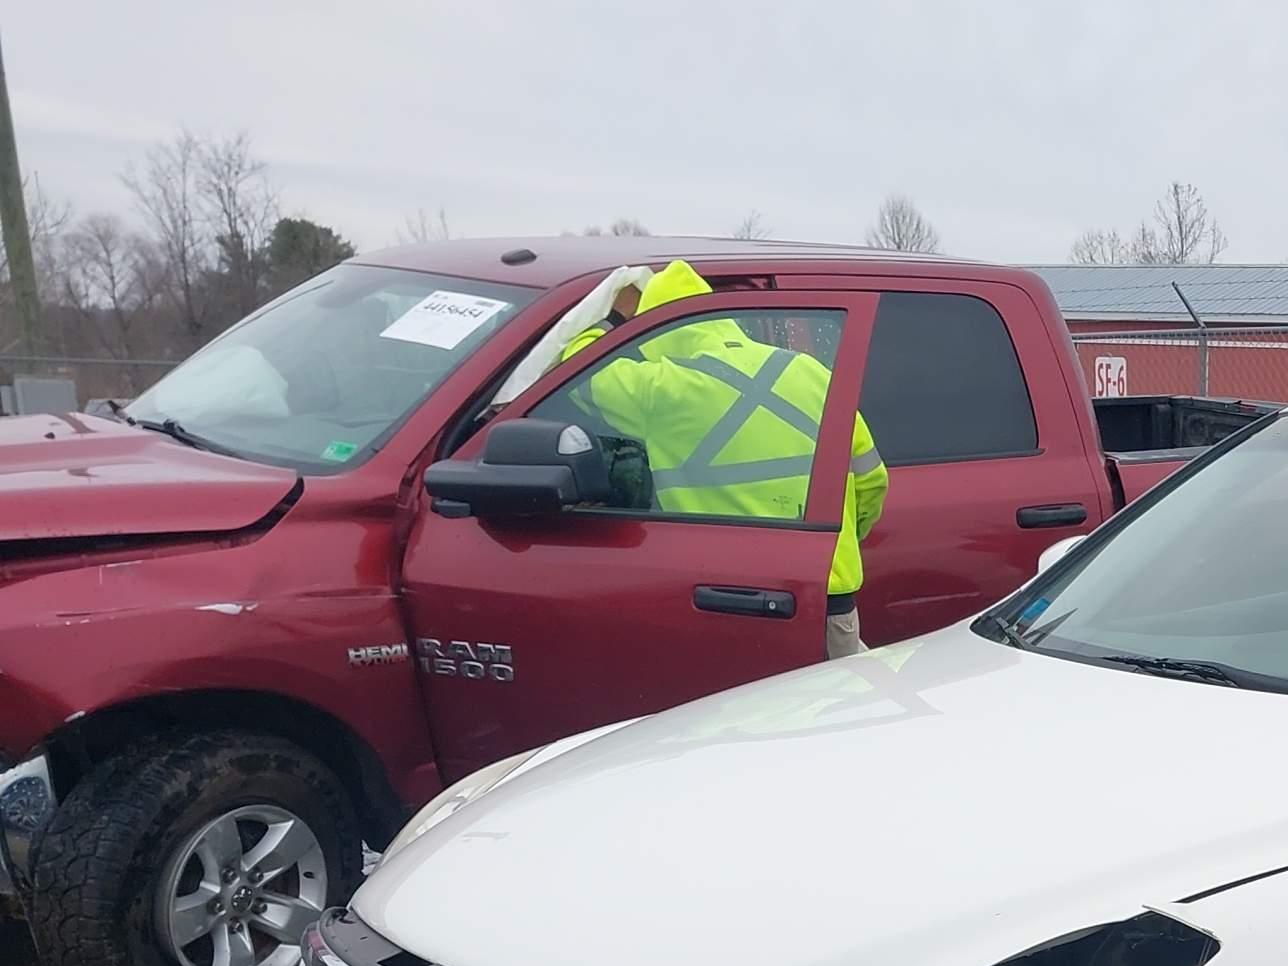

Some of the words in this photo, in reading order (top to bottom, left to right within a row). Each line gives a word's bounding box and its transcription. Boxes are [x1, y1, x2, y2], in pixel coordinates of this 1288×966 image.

[1097, 362, 1125, 397] SF-6
[346, 642, 410, 663] HEMI
[416, 637, 514, 663] RAM
[418, 656, 515, 682] 1500
